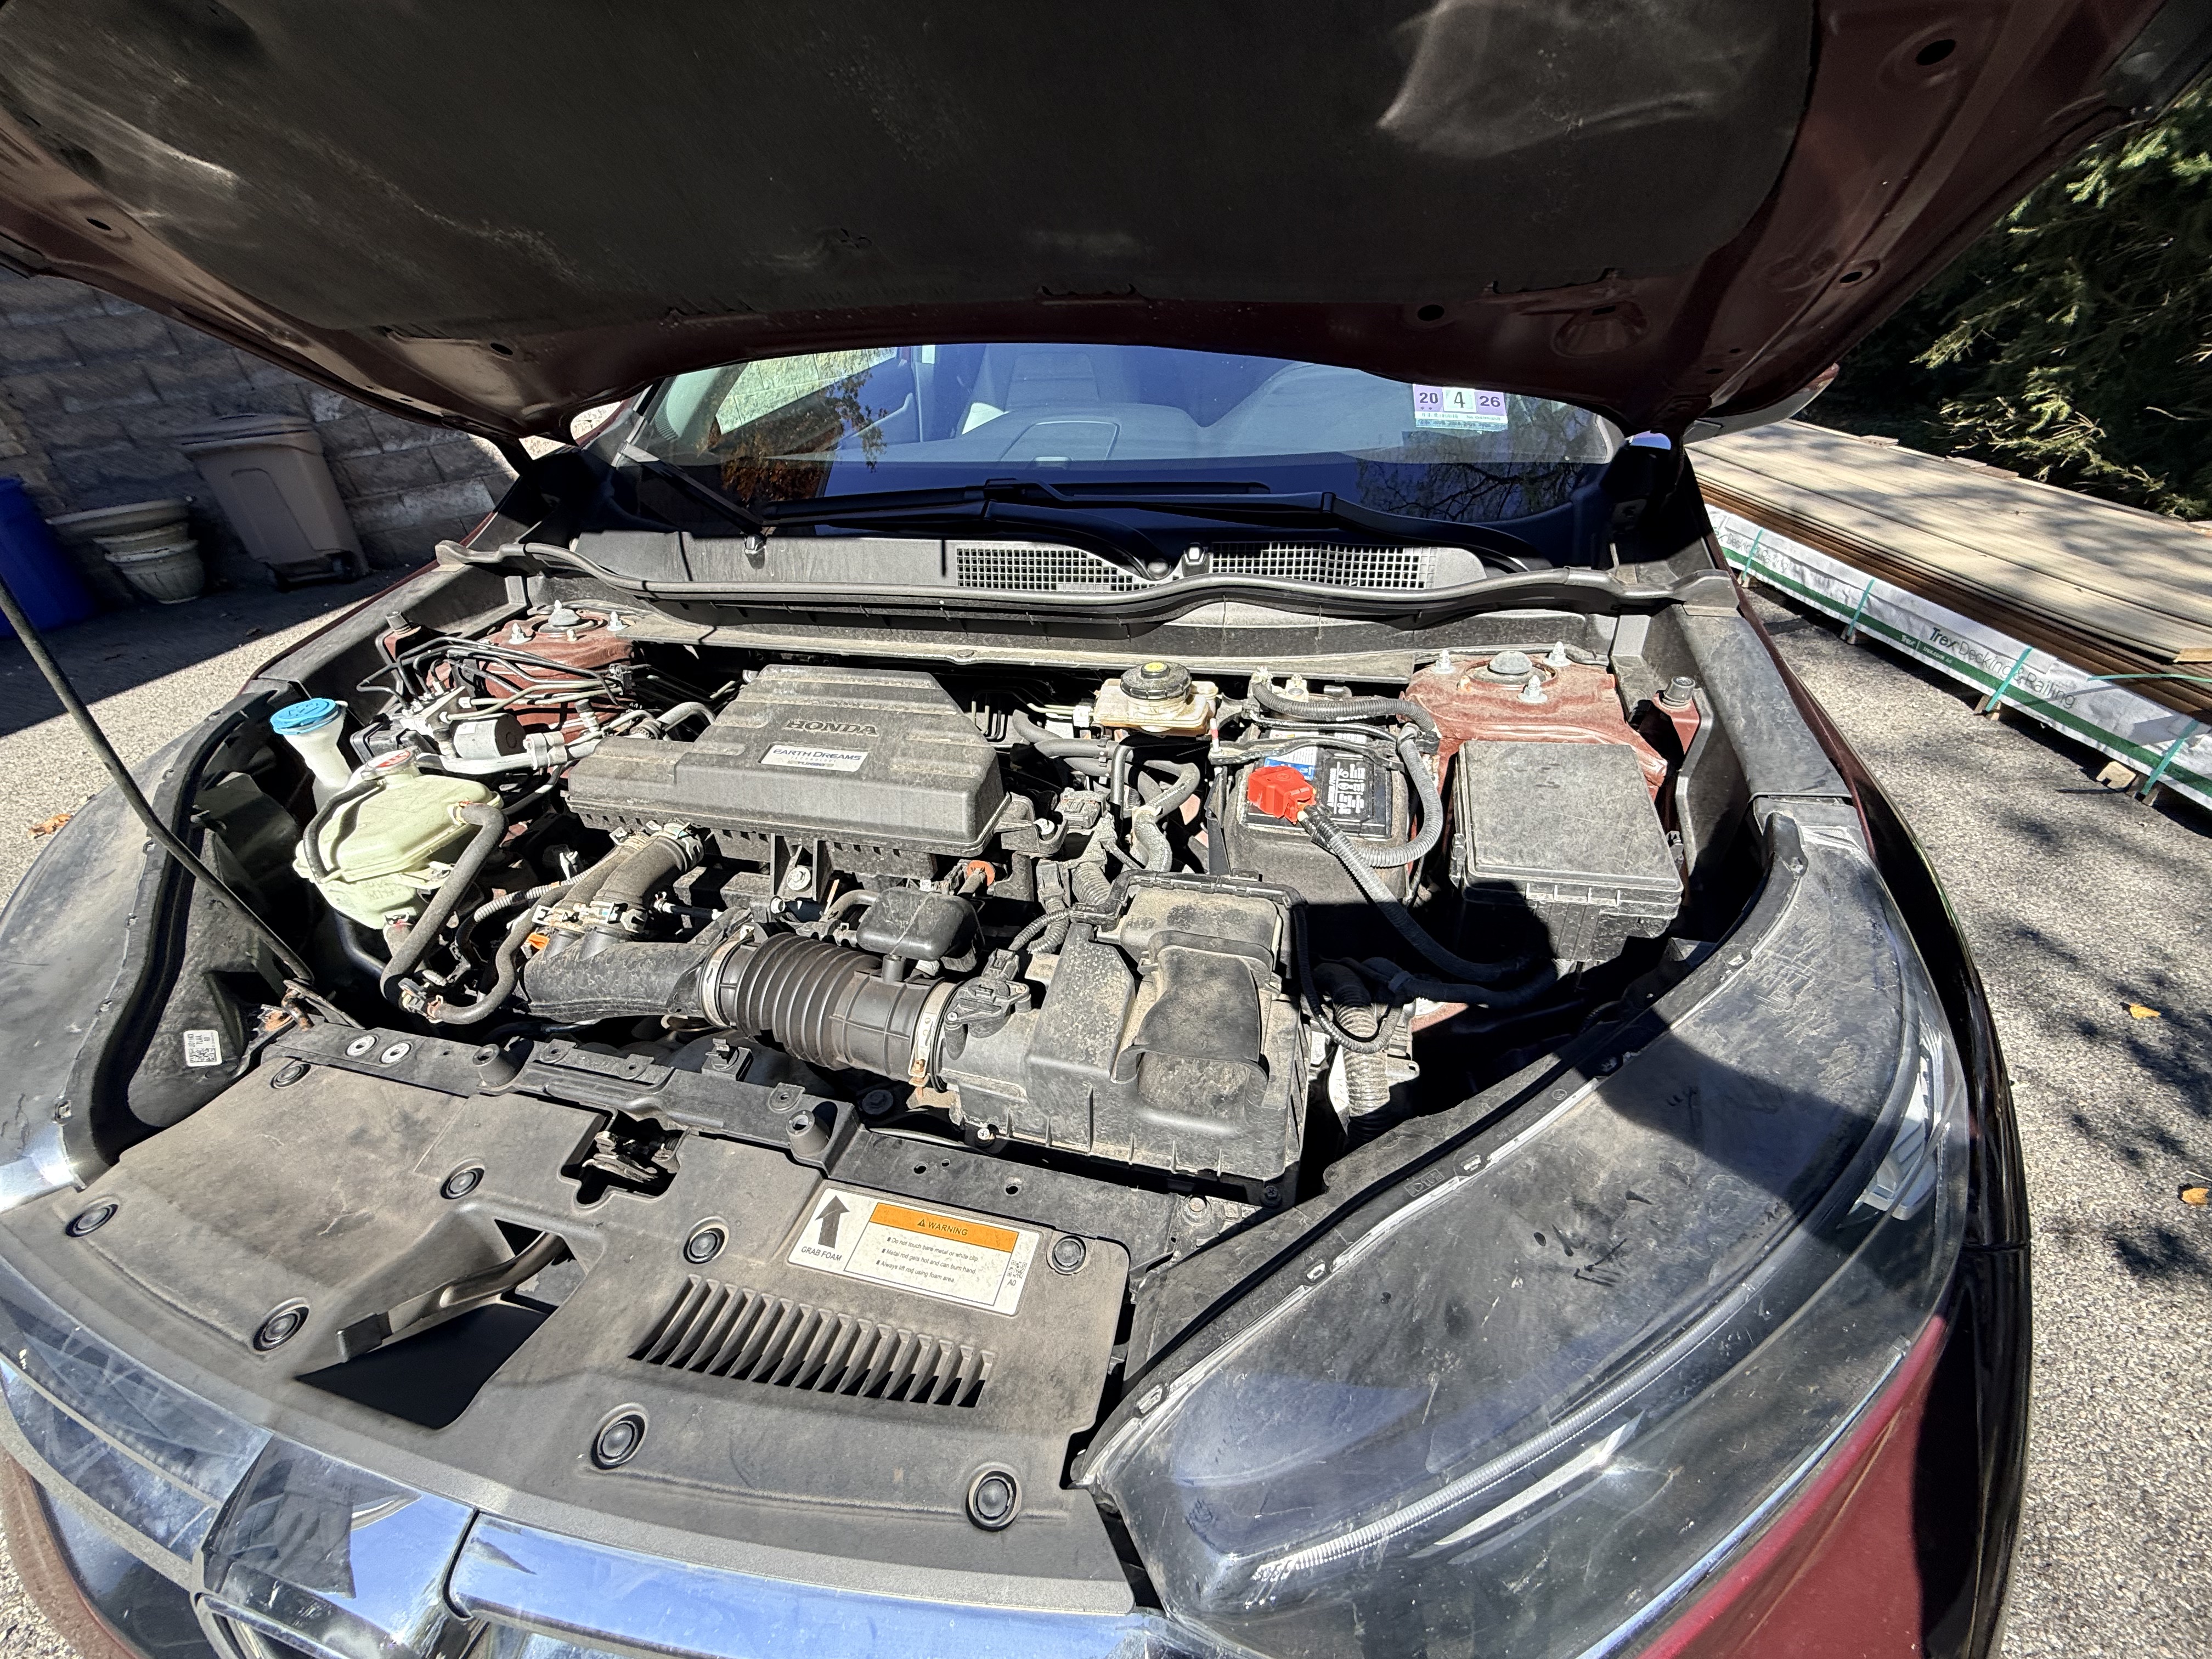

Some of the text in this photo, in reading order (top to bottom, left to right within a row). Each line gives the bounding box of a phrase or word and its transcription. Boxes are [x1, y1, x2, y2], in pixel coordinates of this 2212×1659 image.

[1419, 391, 1500, 409] 20 4 26
[1929, 627, 1957, 648] Trex
[1959, 641, 2012, 679] Decking
[2024, 673, 2076, 709] Railing
[785, 719, 879, 736] HONDA
[812, 751, 862, 760] DREAMS
[928, 1221, 968, 1236] WARNING
[801, 1246, 843, 1261] GRAB FOAM
[880, 1261, 898, 1270] Always
[915, 1269, 929, 1278] using
[929, 1271, 942, 1280] foam
